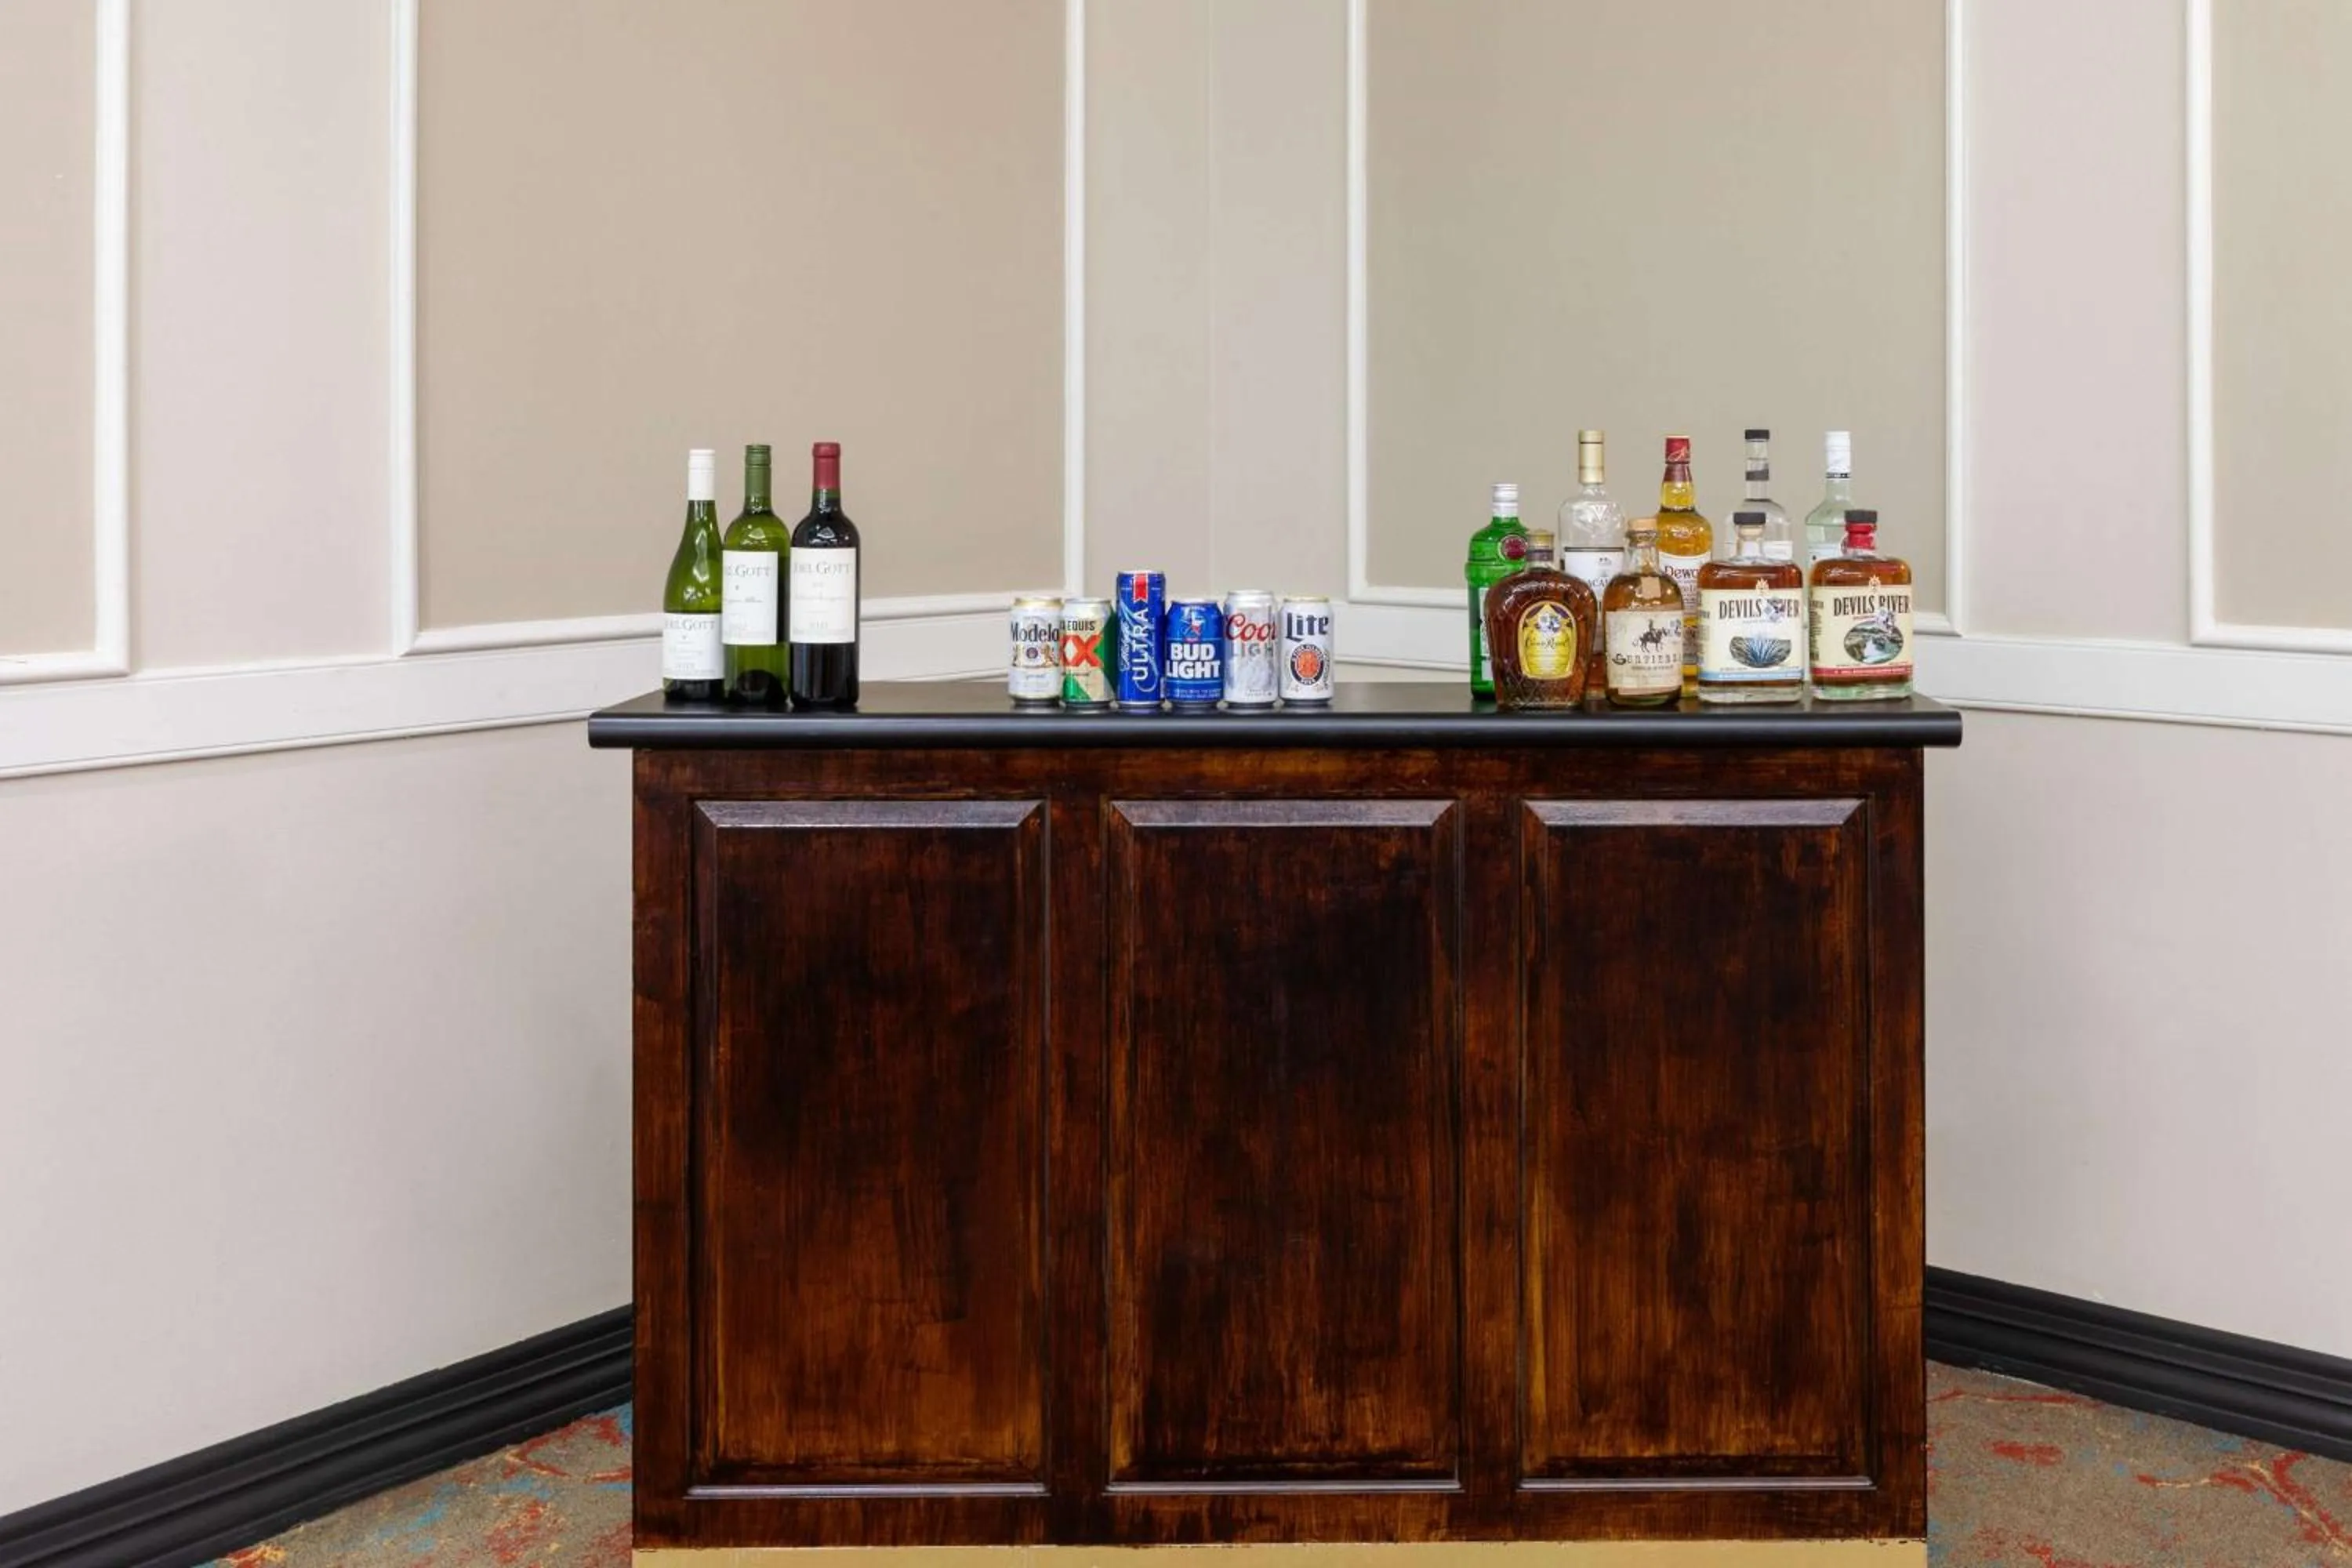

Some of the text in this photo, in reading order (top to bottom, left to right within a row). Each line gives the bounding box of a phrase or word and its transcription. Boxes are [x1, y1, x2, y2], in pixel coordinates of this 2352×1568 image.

[1719, 599, 1762, 619] DEVILS
[1833, 596, 1875, 616] DEVILS
[1011, 621, 1060, 641] Modelo
[1285, 612, 1329, 643] Lite
[1131, 608, 1149, 681] ULTRA
[1171, 643, 1215, 660] BUD
[1166, 660, 1221, 679] LIGHT
